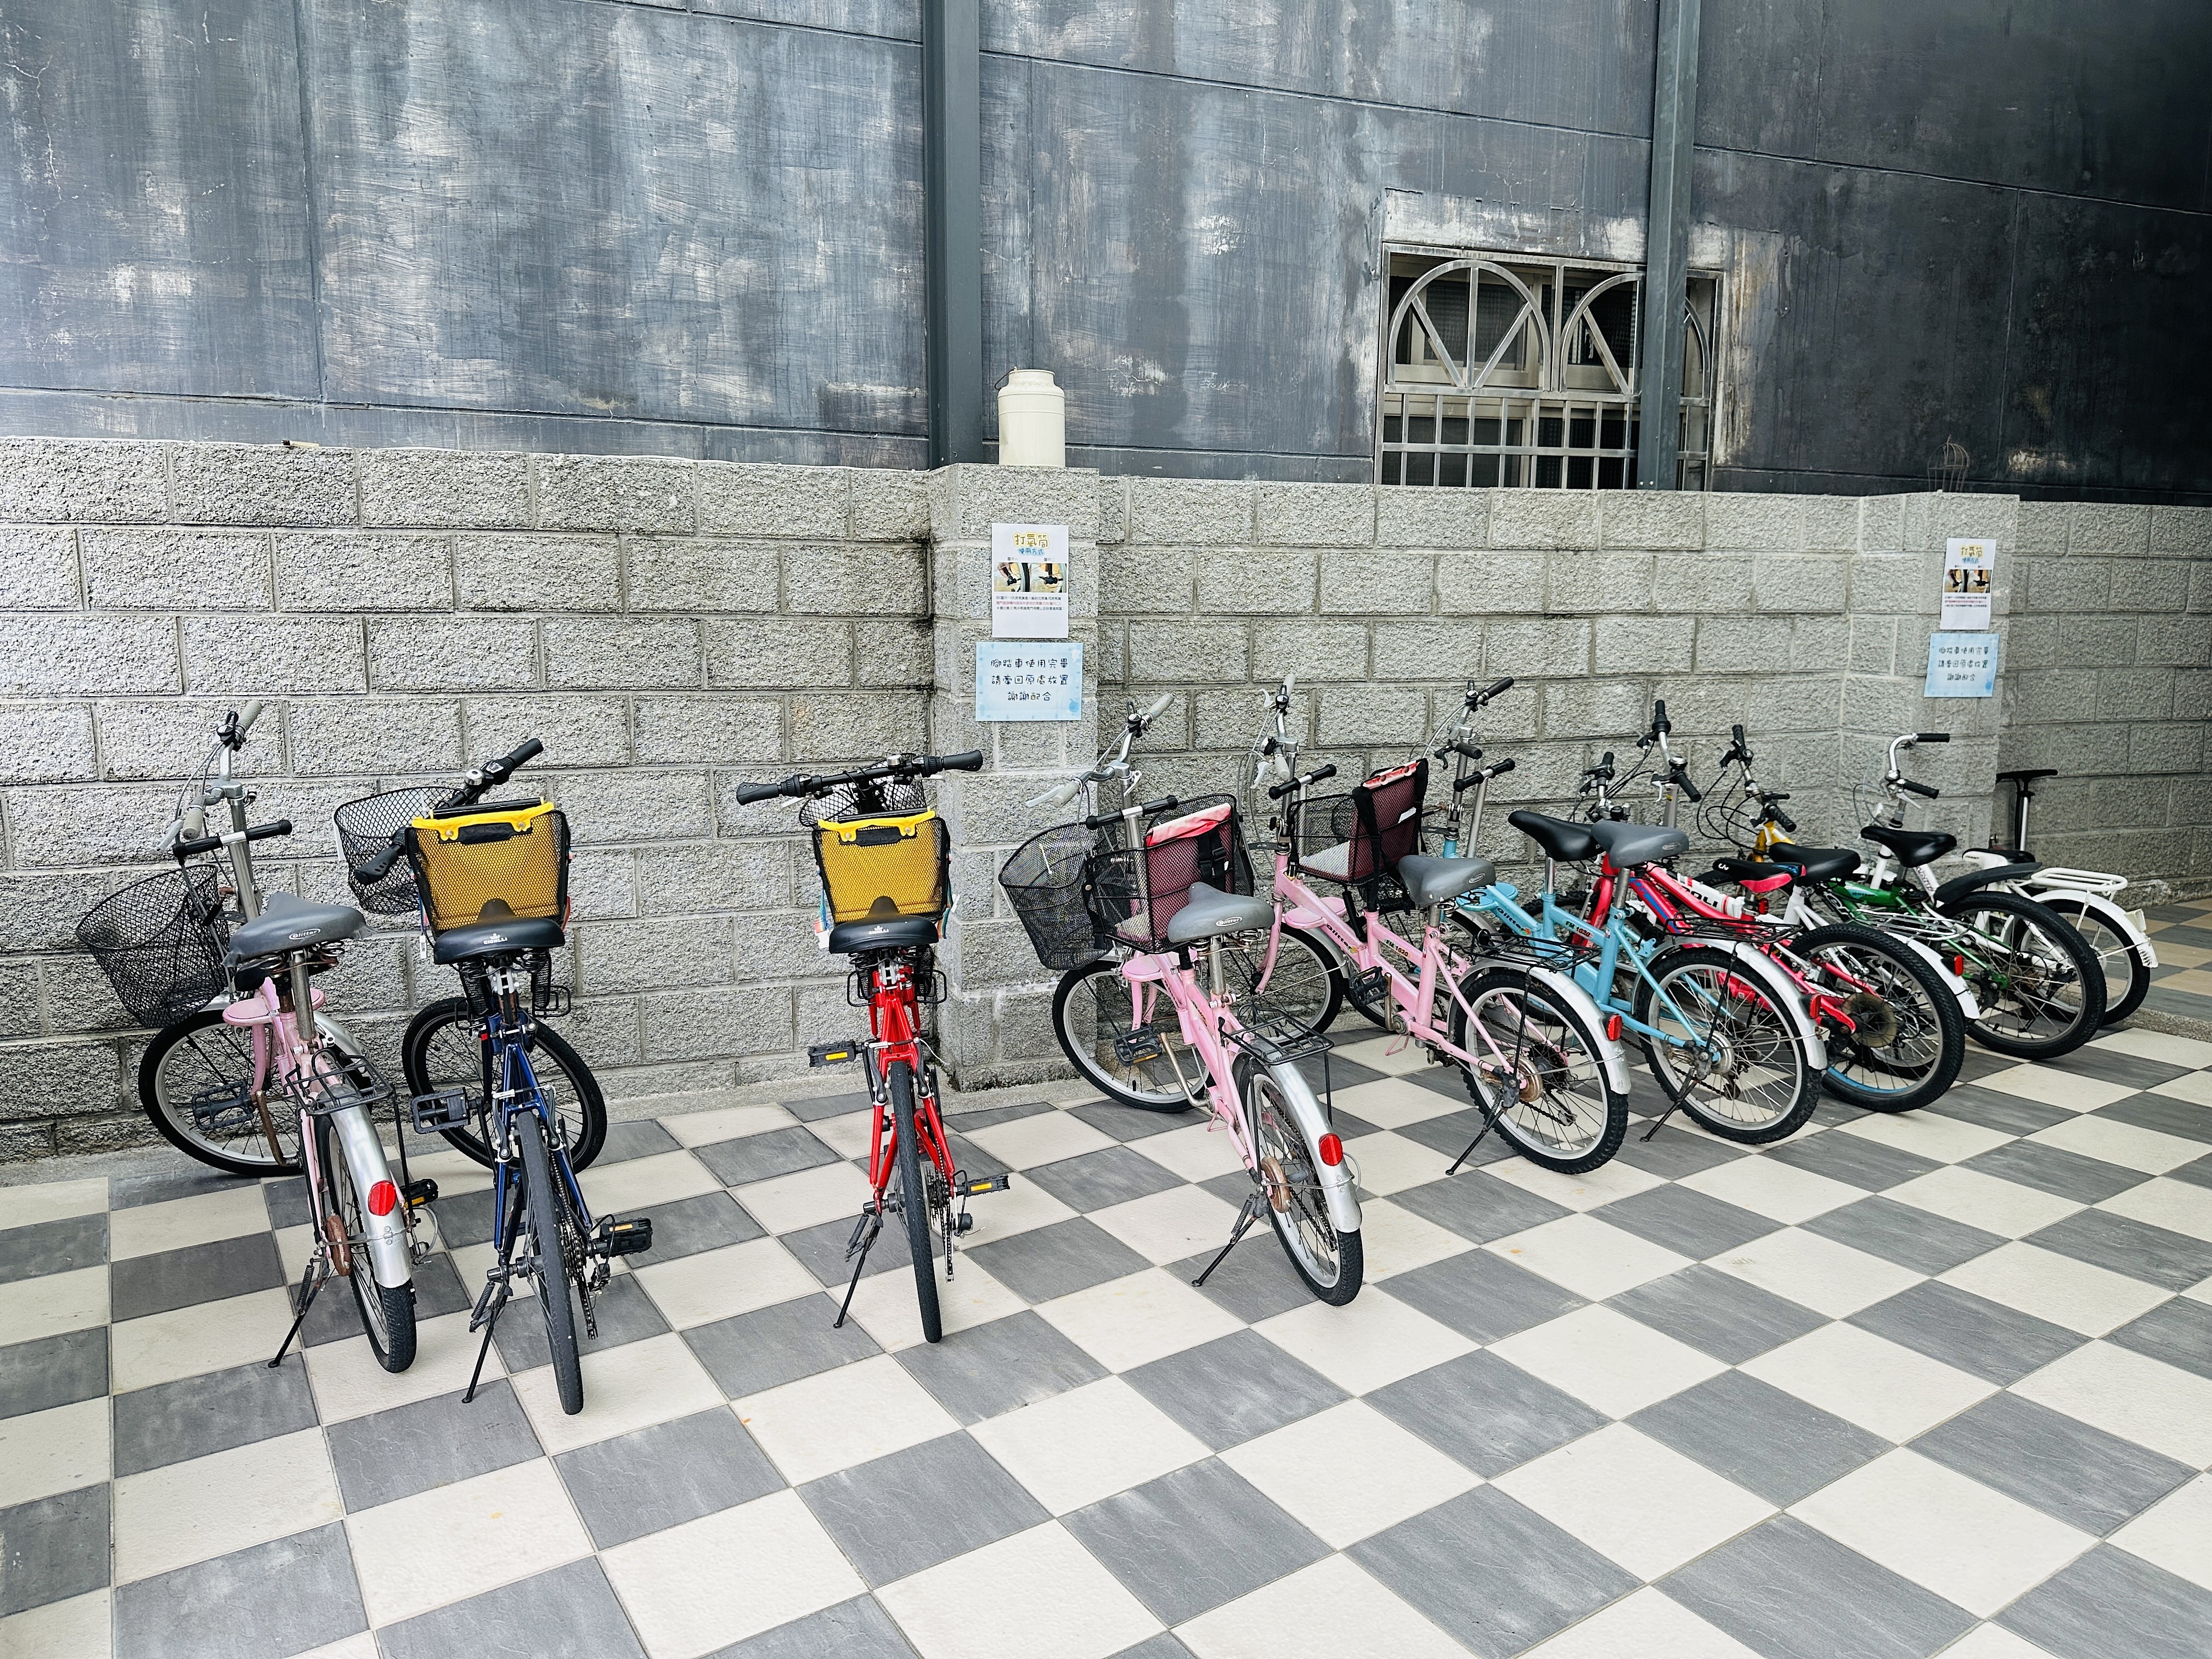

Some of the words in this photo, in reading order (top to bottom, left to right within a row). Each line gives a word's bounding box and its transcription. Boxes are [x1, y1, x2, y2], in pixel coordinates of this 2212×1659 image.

[1014, 533, 1048, 548] 打氣筒
[991, 658, 1068, 668] 腳踏車使用完畢
[991, 674, 1069, 685] 請牽回原處放置
[1007, 691, 1051, 701] 謝謝配合
[1497, 907, 1525, 931] Glitter
[292, 930, 318, 938] Glitter
[1565, 921, 1575, 929] FM
[1576, 927, 1590, 936] 1020
[1327, 923, 1353, 950] Glitter
[1385, 939, 1395, 948] FM
[1395, 945, 1409, 957] 1020
